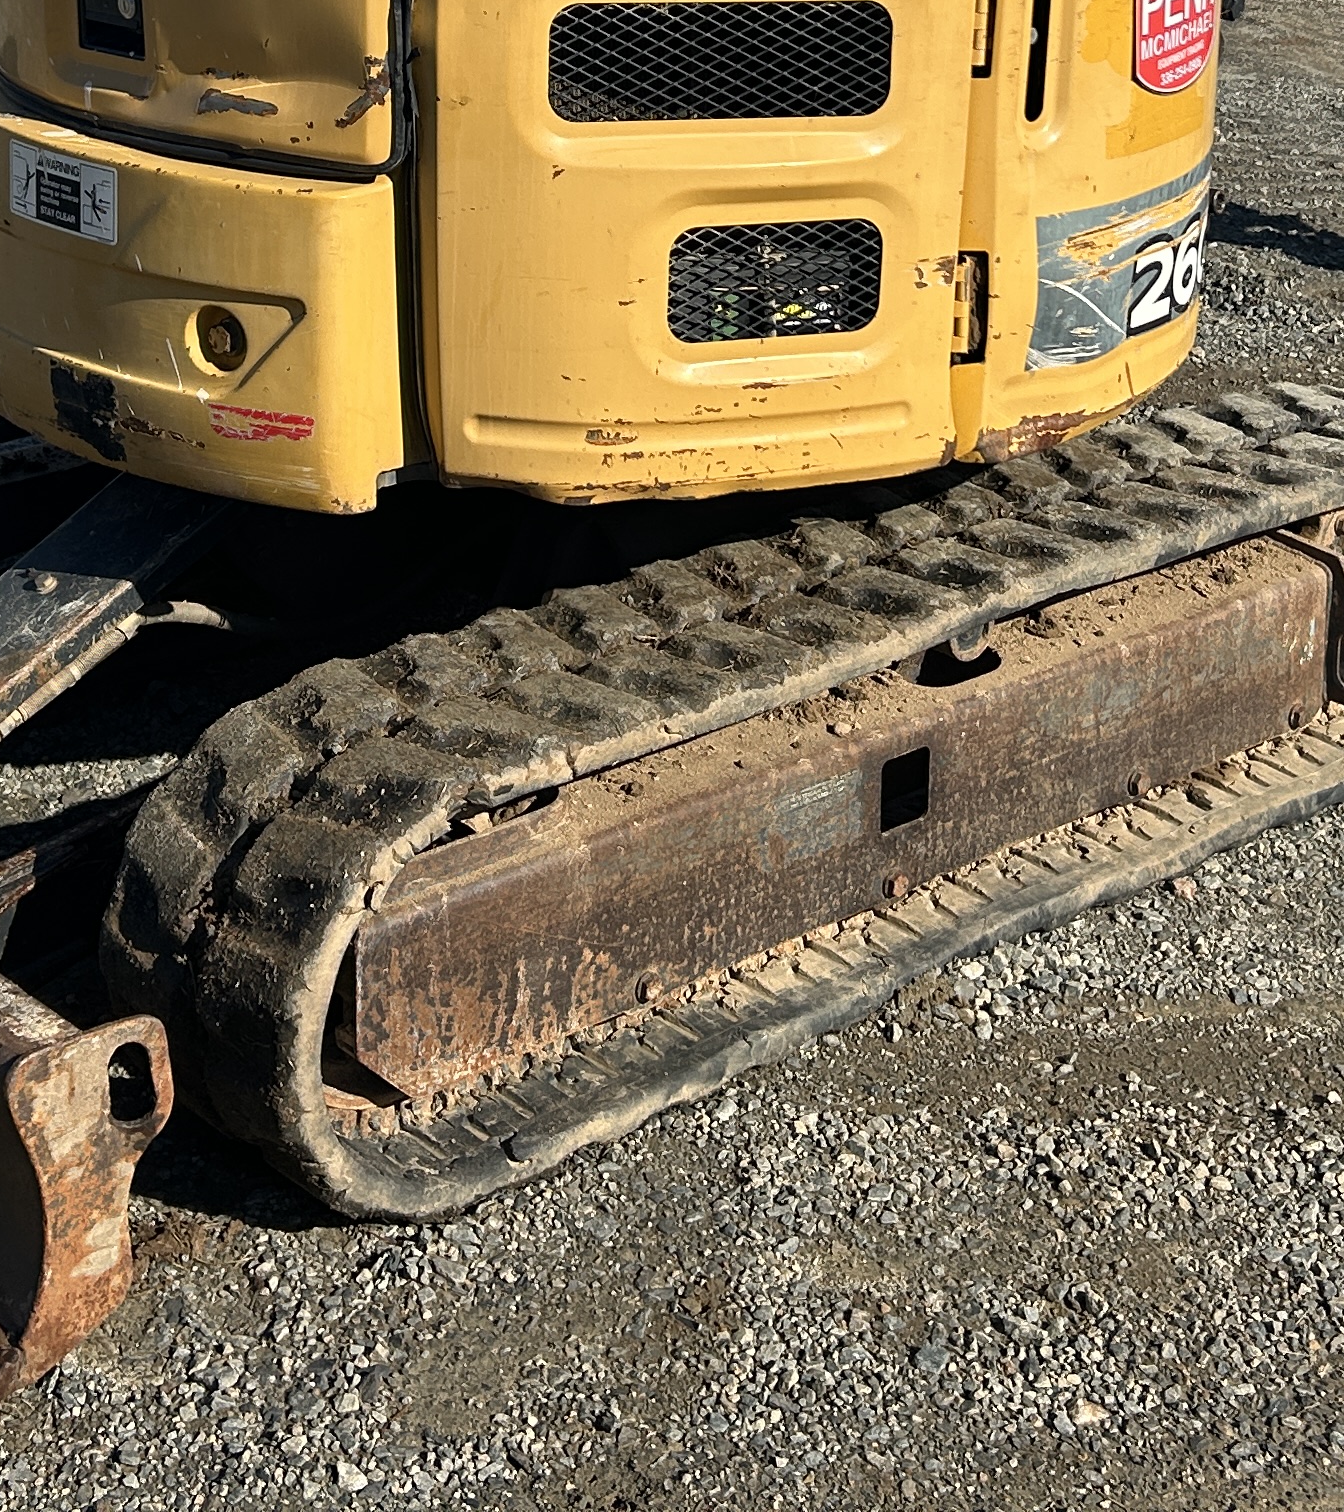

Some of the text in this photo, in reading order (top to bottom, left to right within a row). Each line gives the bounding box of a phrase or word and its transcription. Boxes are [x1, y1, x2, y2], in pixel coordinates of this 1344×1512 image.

[45, 157, 80, 178] WARNING
[40, 205, 76, 224] STAY CLEAR
[1129, 214, 1204, 332] 26
